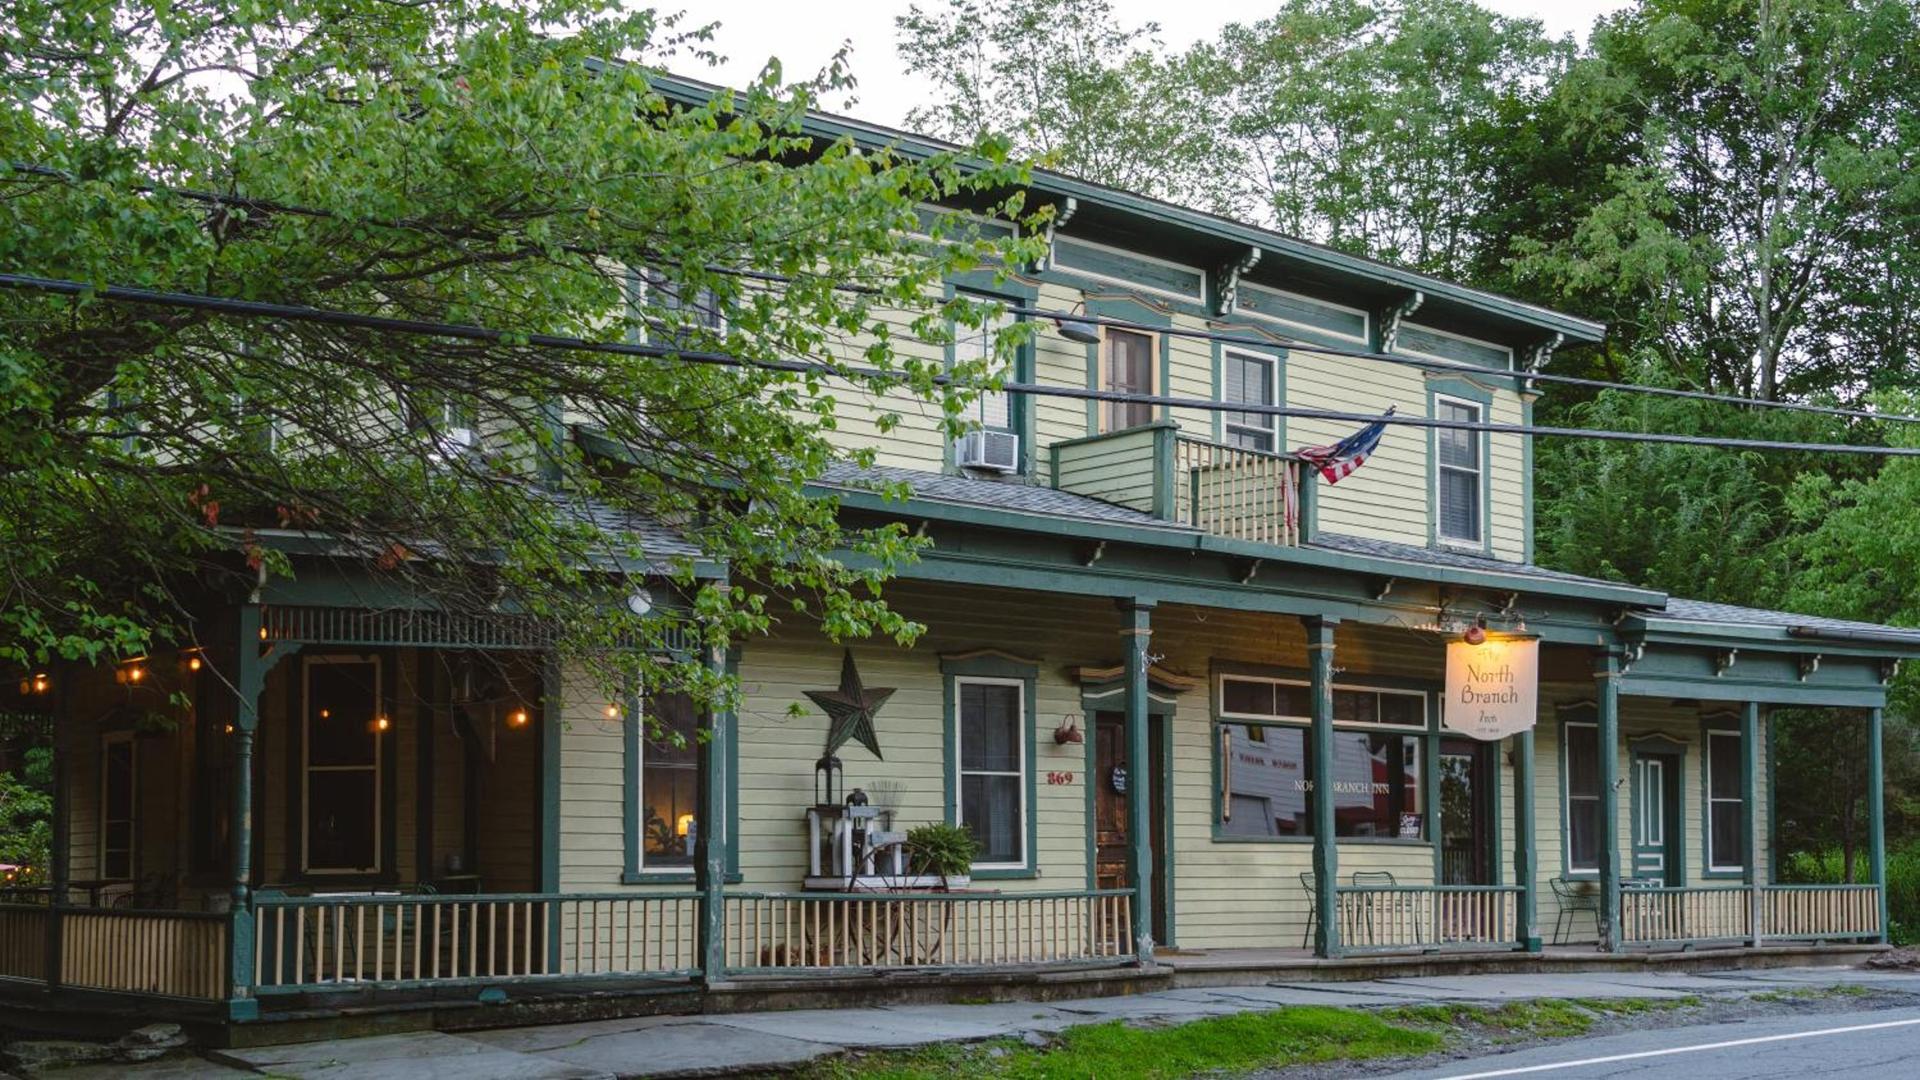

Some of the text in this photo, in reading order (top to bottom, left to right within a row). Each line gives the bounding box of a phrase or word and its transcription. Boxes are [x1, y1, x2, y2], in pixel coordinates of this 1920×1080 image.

[1467, 664, 1514, 683] North
[1461, 684, 1518, 704] Branch
[1479, 710, 1498, 723] Inn
[1047, 771, 1073, 785] 869
[1371, 783, 1390, 794] INN
